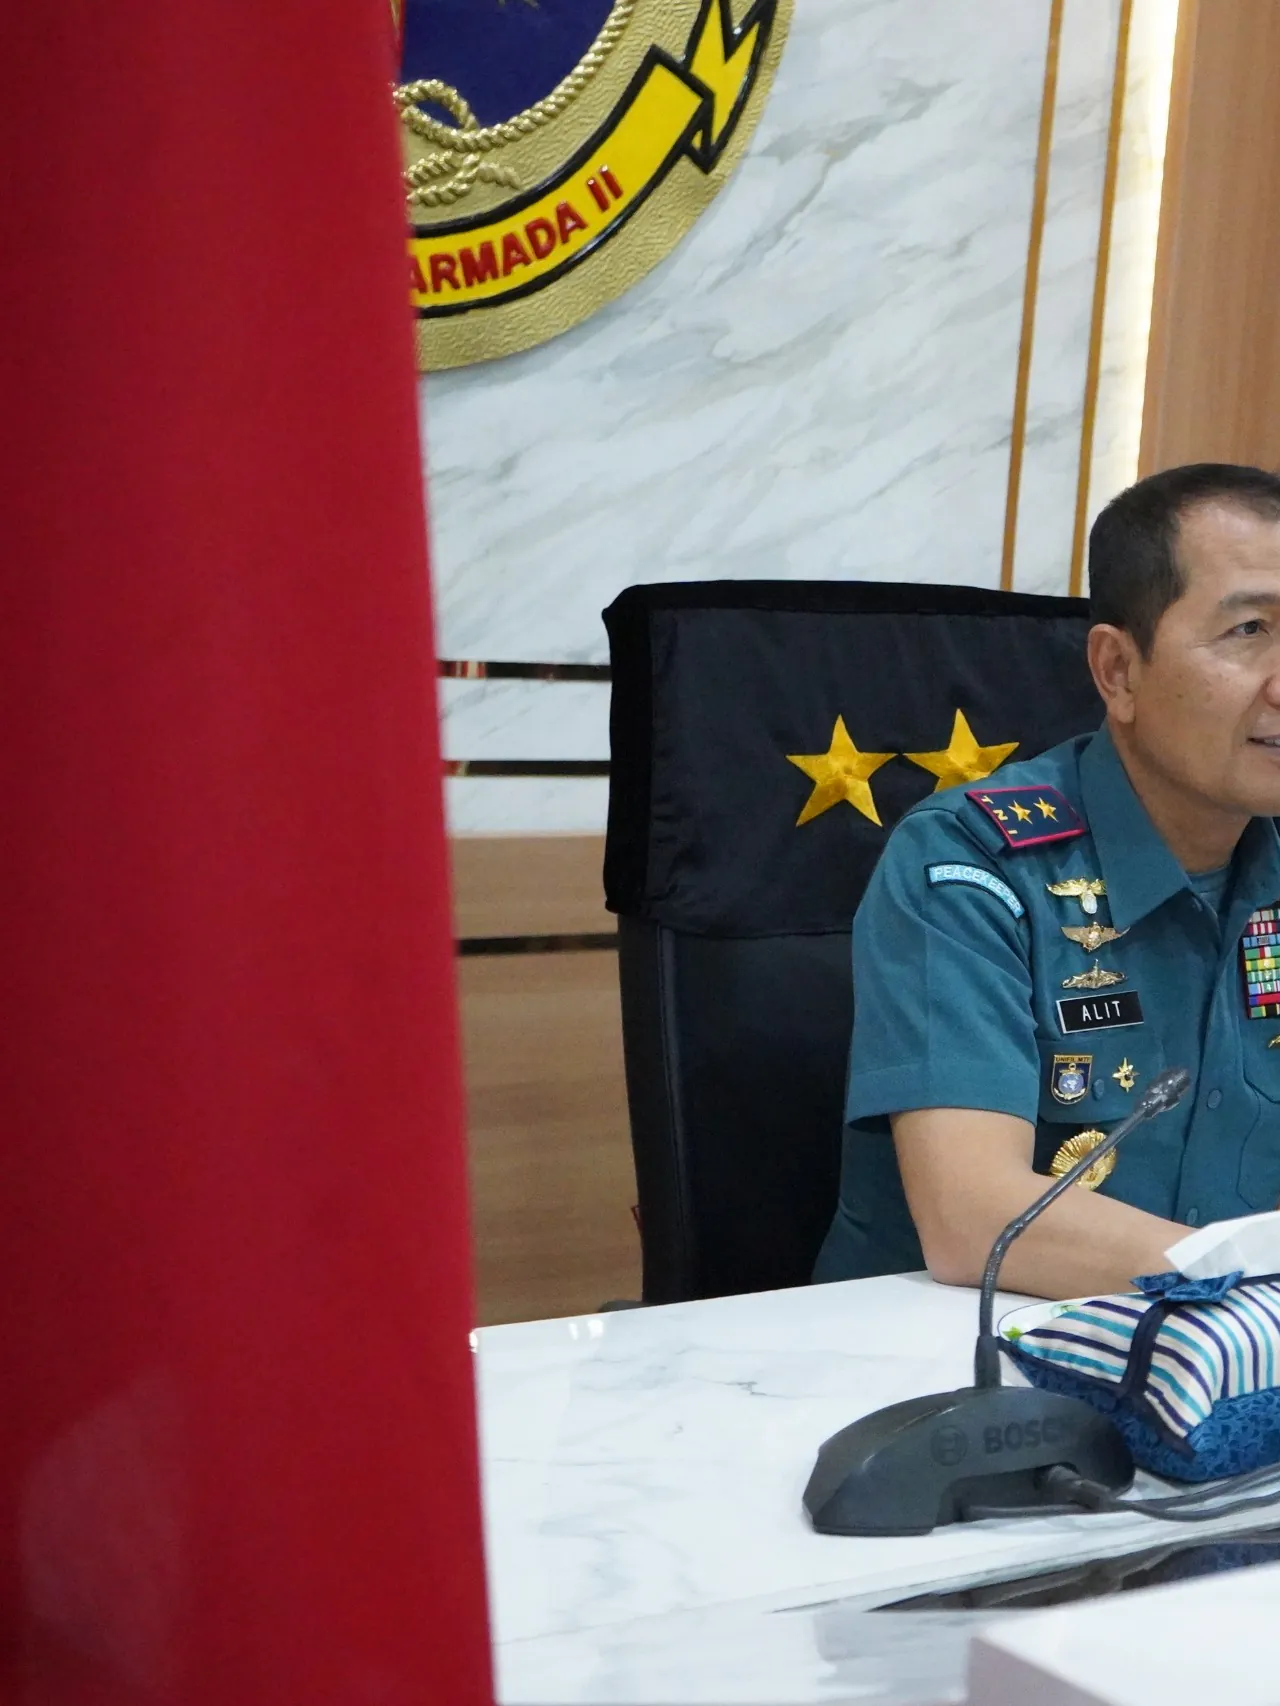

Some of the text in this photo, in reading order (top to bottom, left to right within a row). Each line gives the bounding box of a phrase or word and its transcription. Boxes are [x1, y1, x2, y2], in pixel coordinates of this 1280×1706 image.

[408, 164, 624, 294] ARMADA II
[981, 795, 1018, 835] TNI
[934, 866, 1022, 912] PEACEKEEPER
[1082, 1001, 1121, 1022] ALIT
